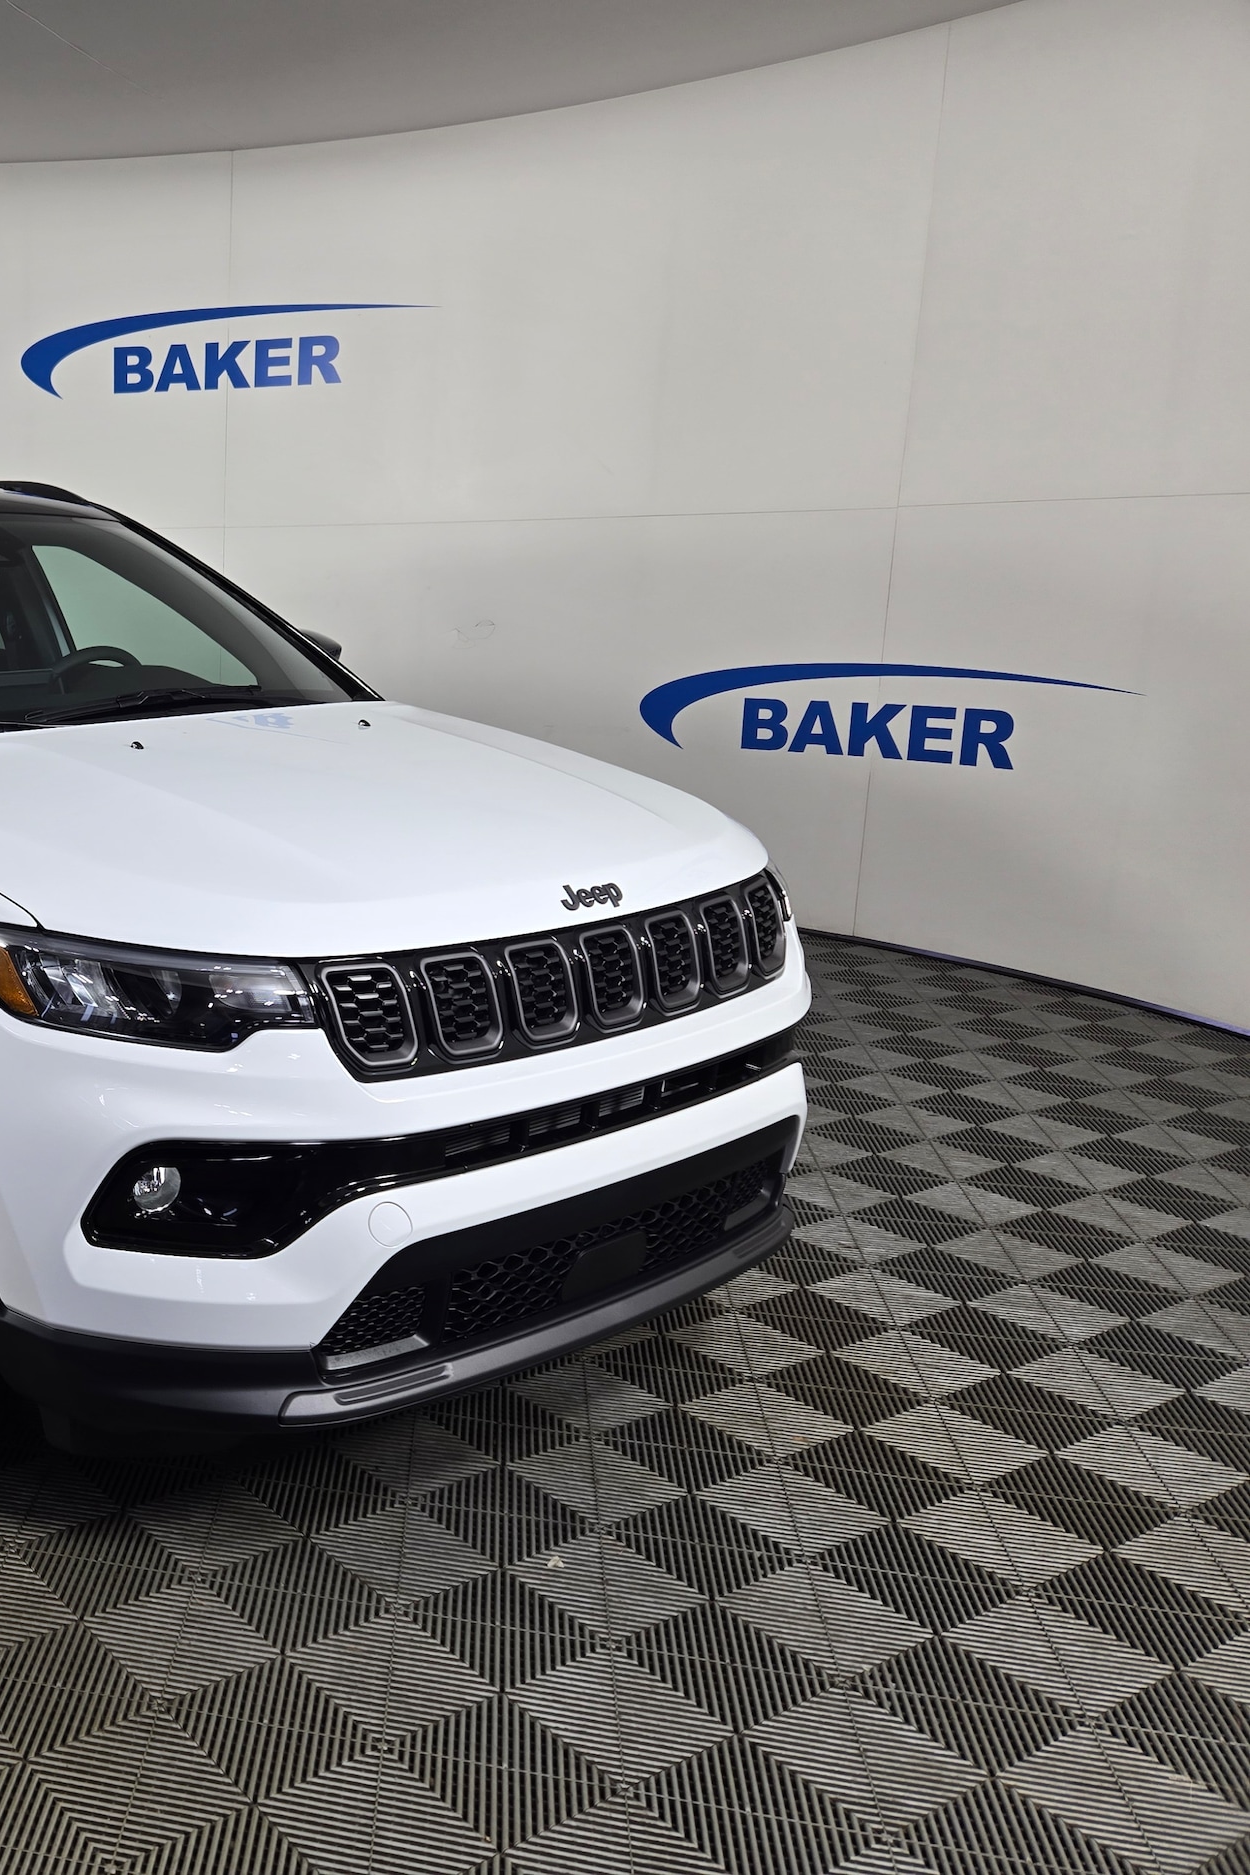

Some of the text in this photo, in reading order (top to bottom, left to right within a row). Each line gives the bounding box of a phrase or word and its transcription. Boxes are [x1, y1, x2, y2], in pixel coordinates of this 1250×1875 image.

[113, 334, 343, 395] BAKER
[740, 697, 1015, 771] BAKER
[560, 882, 623, 911] Jeep
